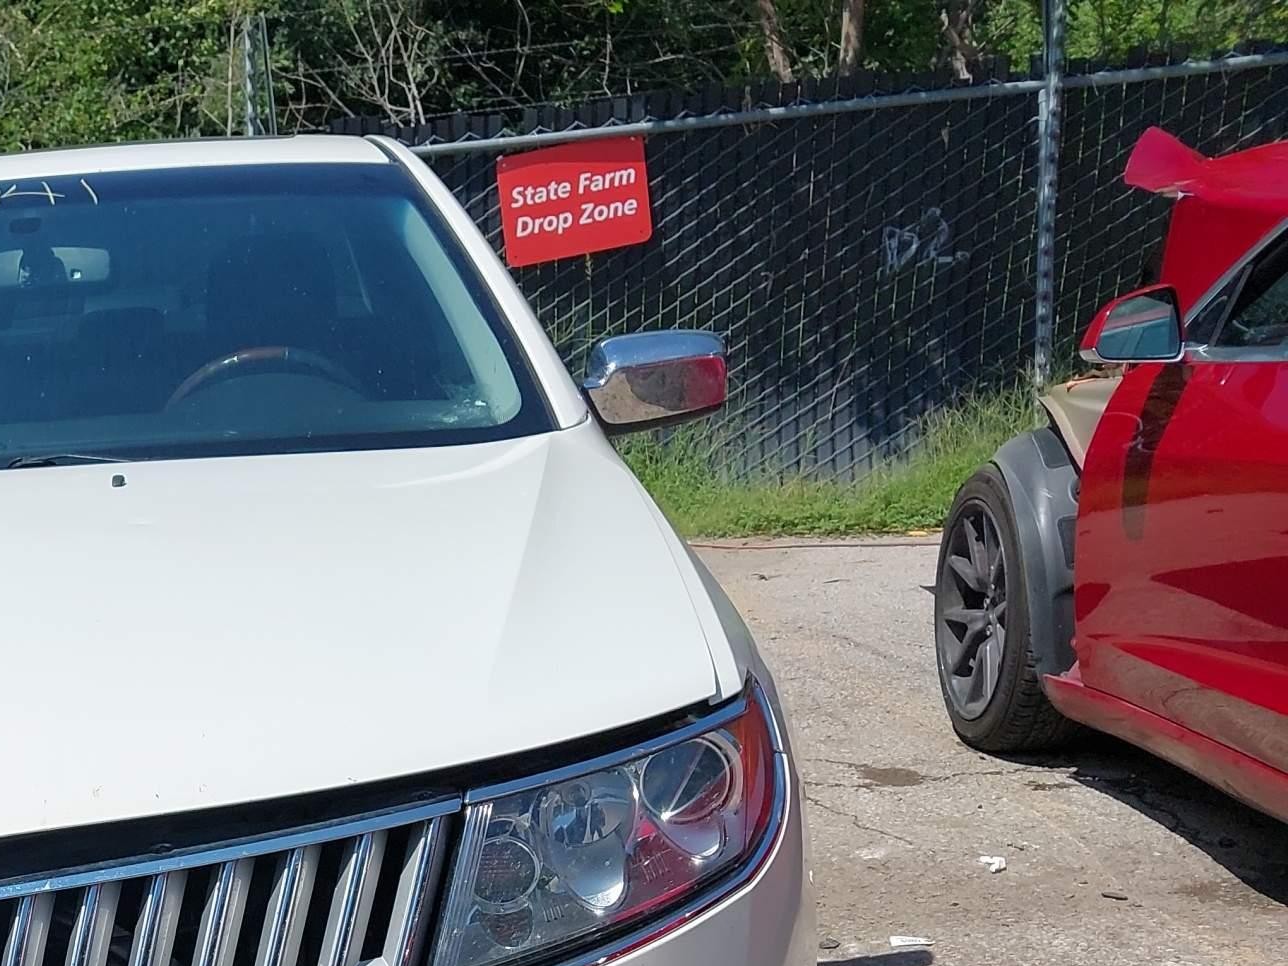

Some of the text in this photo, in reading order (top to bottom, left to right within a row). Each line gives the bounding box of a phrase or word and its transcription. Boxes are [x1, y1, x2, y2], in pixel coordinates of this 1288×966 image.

[511, 167, 636, 208] State Farm
[516, 198, 638, 238] Drop Zone
